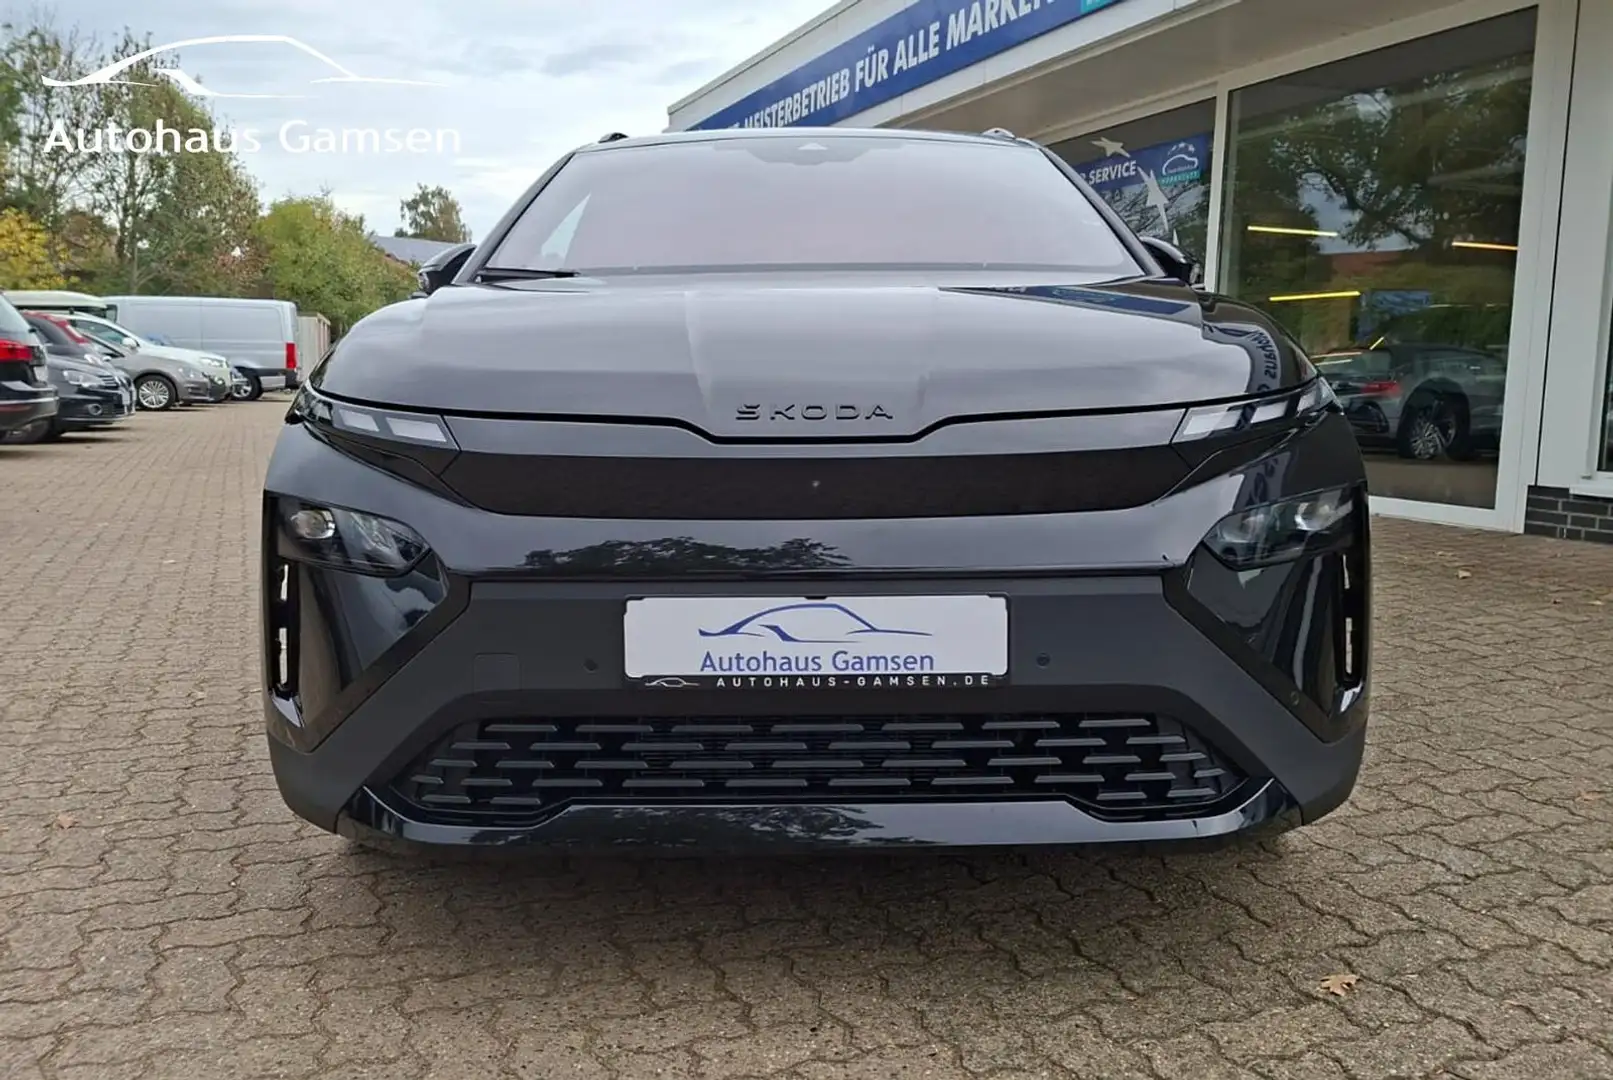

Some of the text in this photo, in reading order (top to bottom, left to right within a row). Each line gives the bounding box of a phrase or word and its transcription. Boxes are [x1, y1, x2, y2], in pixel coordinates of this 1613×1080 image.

[855, 44, 889, 93] FÜR
[893, 21, 940, 76] ALLE
[945, 0, 1056, 51] MARK
[1088, 160, 1137, 185] SERVICE
[700, 650, 934, 672] Autohaus Gamsen
[716, 676, 990, 688] AUTOHAUS-GAMSEN.DE
